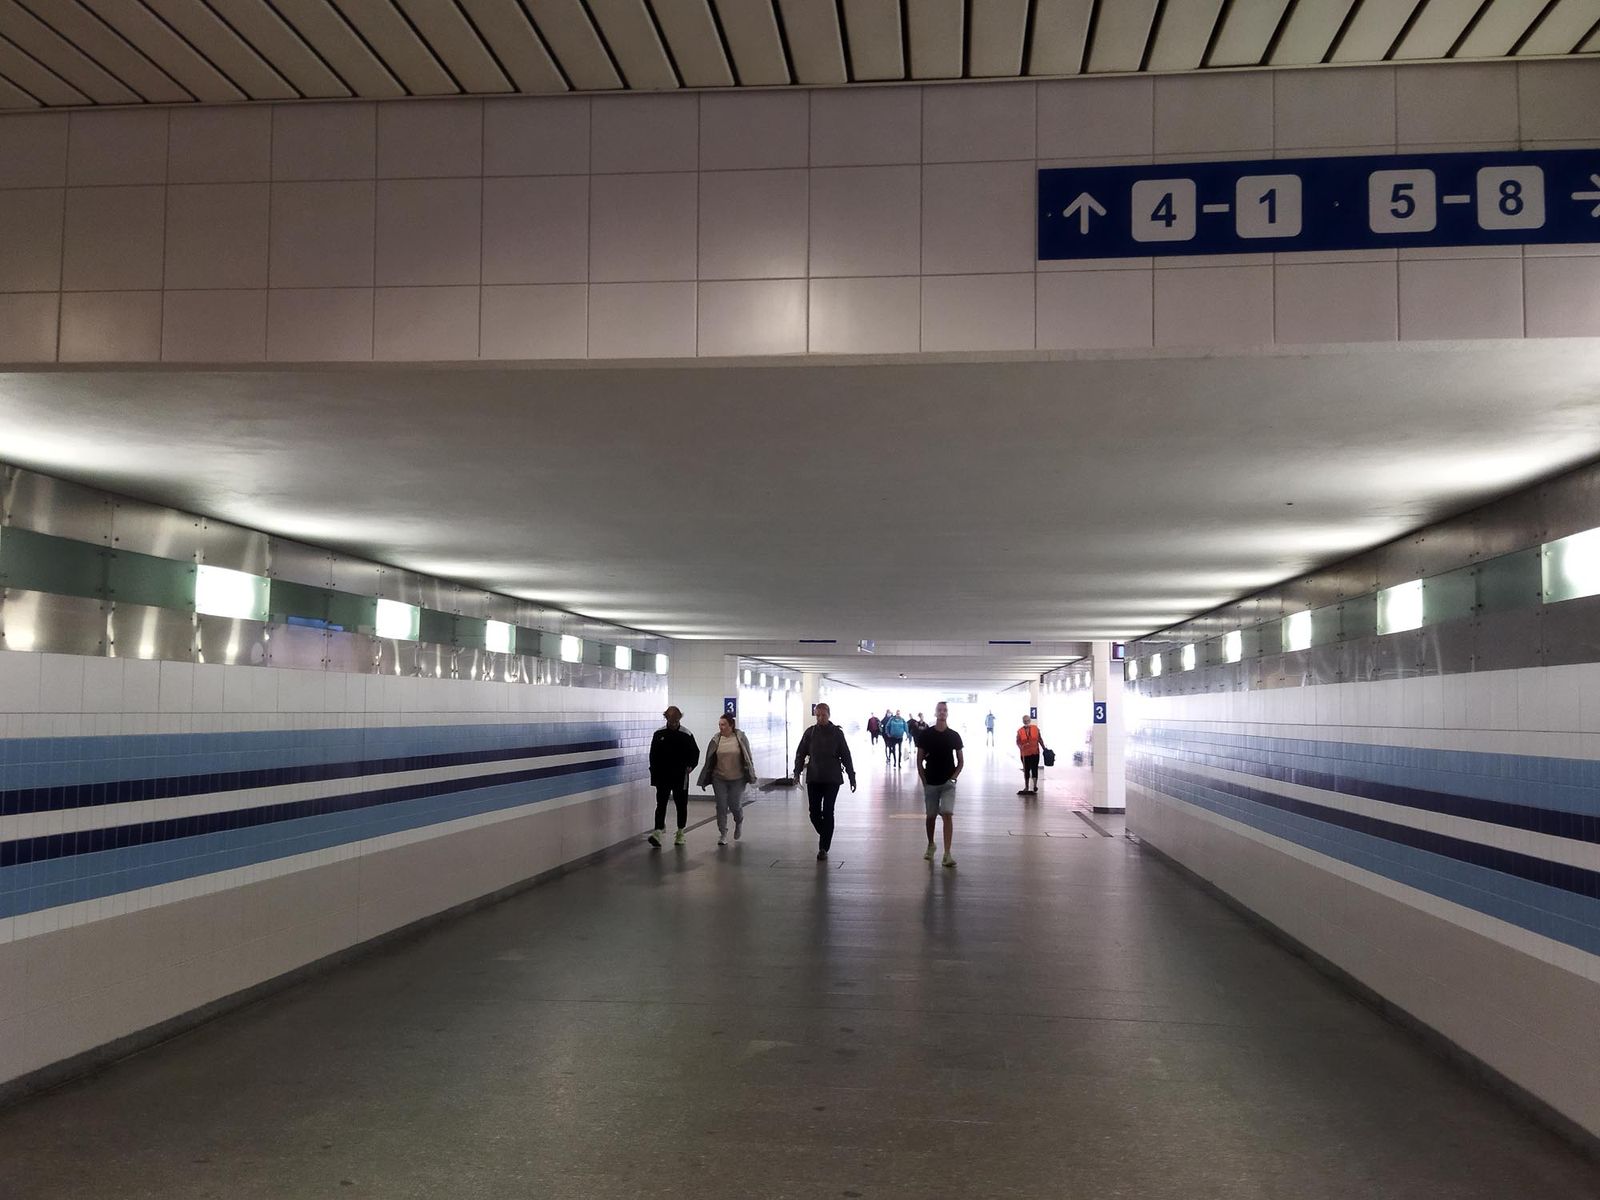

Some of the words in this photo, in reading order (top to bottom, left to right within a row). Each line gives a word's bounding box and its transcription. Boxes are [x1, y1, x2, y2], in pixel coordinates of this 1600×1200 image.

[1150, 192, 1177, 228] 4
[1259, 188, 1278, 224] 1
[1390, 183, 1416, 219] 5
[1498, 179, 1524, 216] 8
[727, 701, 735, 713] 3
[1095, 705, 1104, 720] 3
